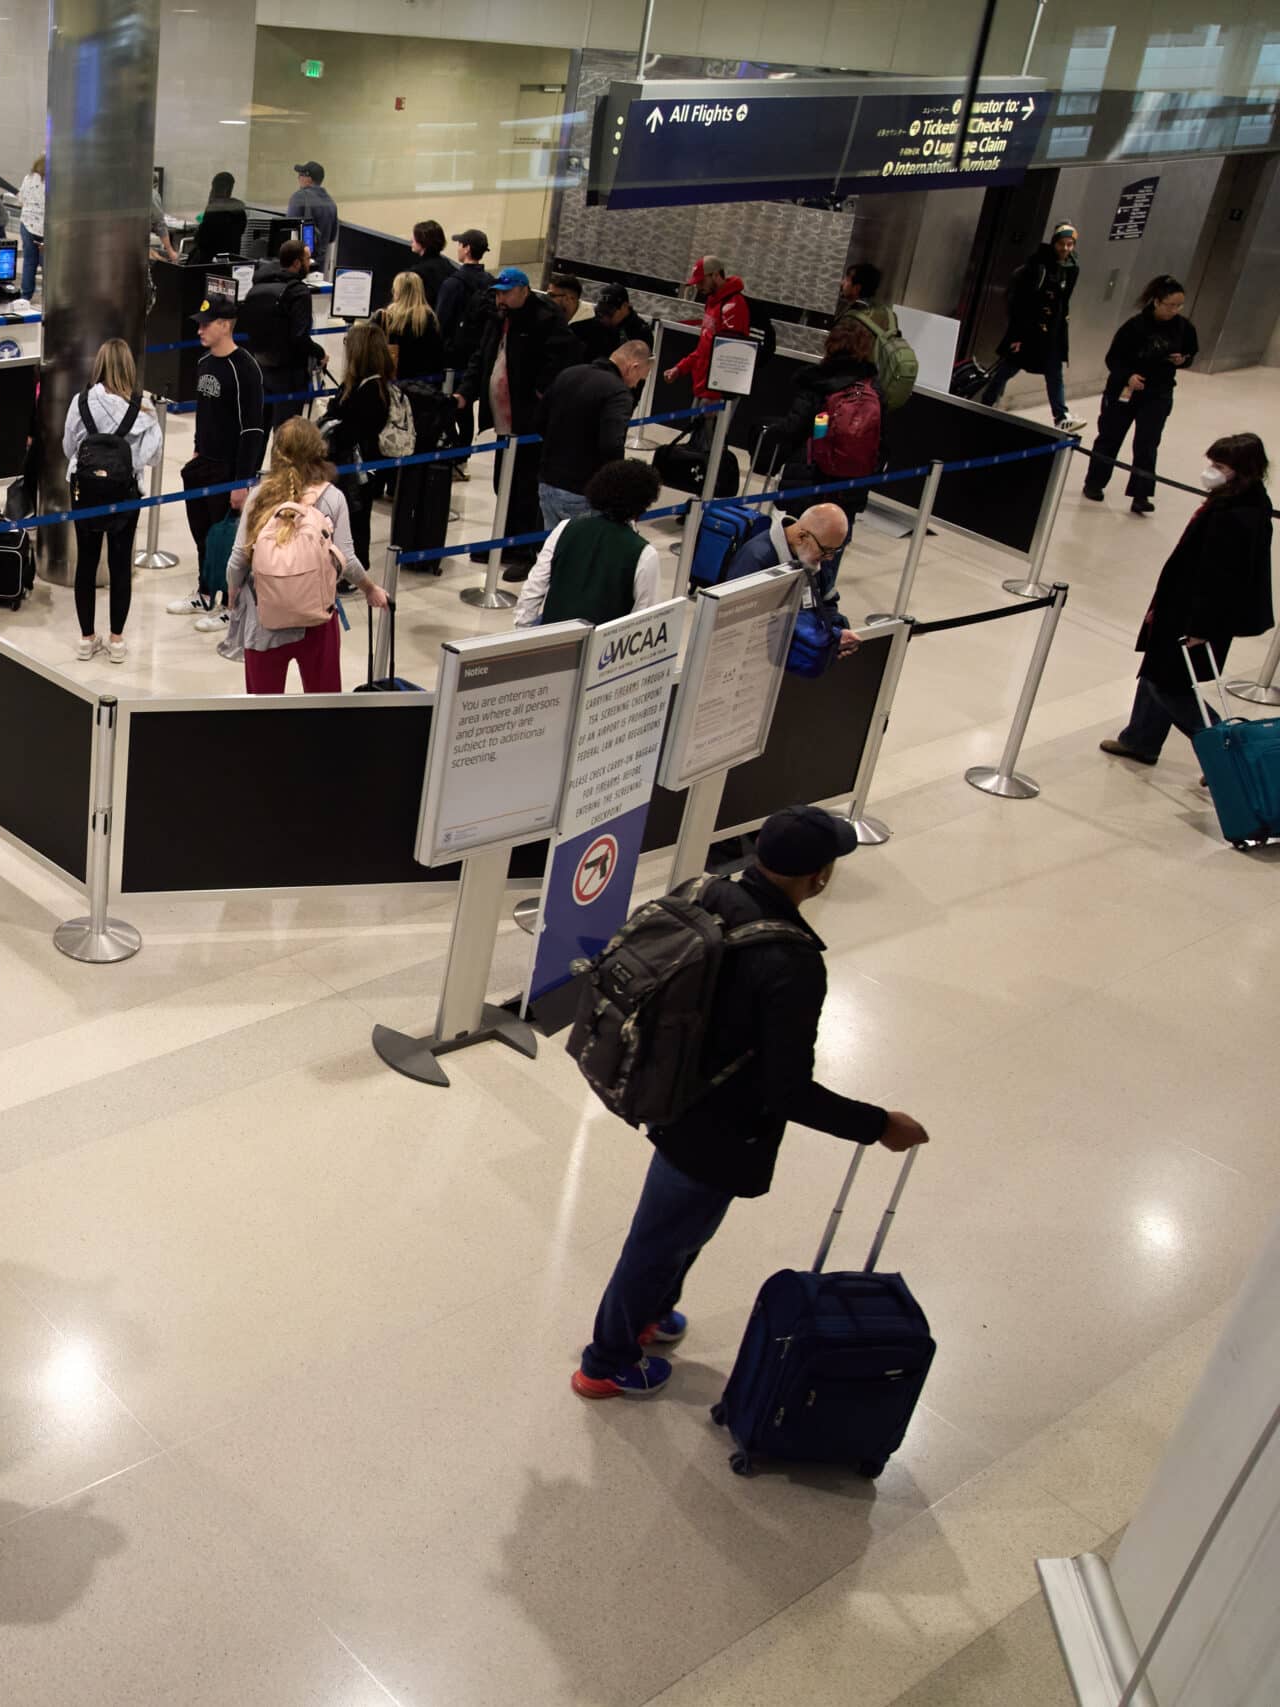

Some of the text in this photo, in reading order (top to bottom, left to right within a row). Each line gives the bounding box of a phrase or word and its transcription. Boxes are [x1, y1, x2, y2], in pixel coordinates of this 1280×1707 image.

[669, 103, 734, 127] All Flights
[979, 136, 1007, 152] Claim
[610, 621, 668, 664] WCAA
[464, 666, 489, 678] Notice
[462, 686, 549, 711] You are entering an
[458, 696, 561, 726] area where all persons
[456, 716, 534, 740] and property are
[453, 727, 545, 755] subject to additional
